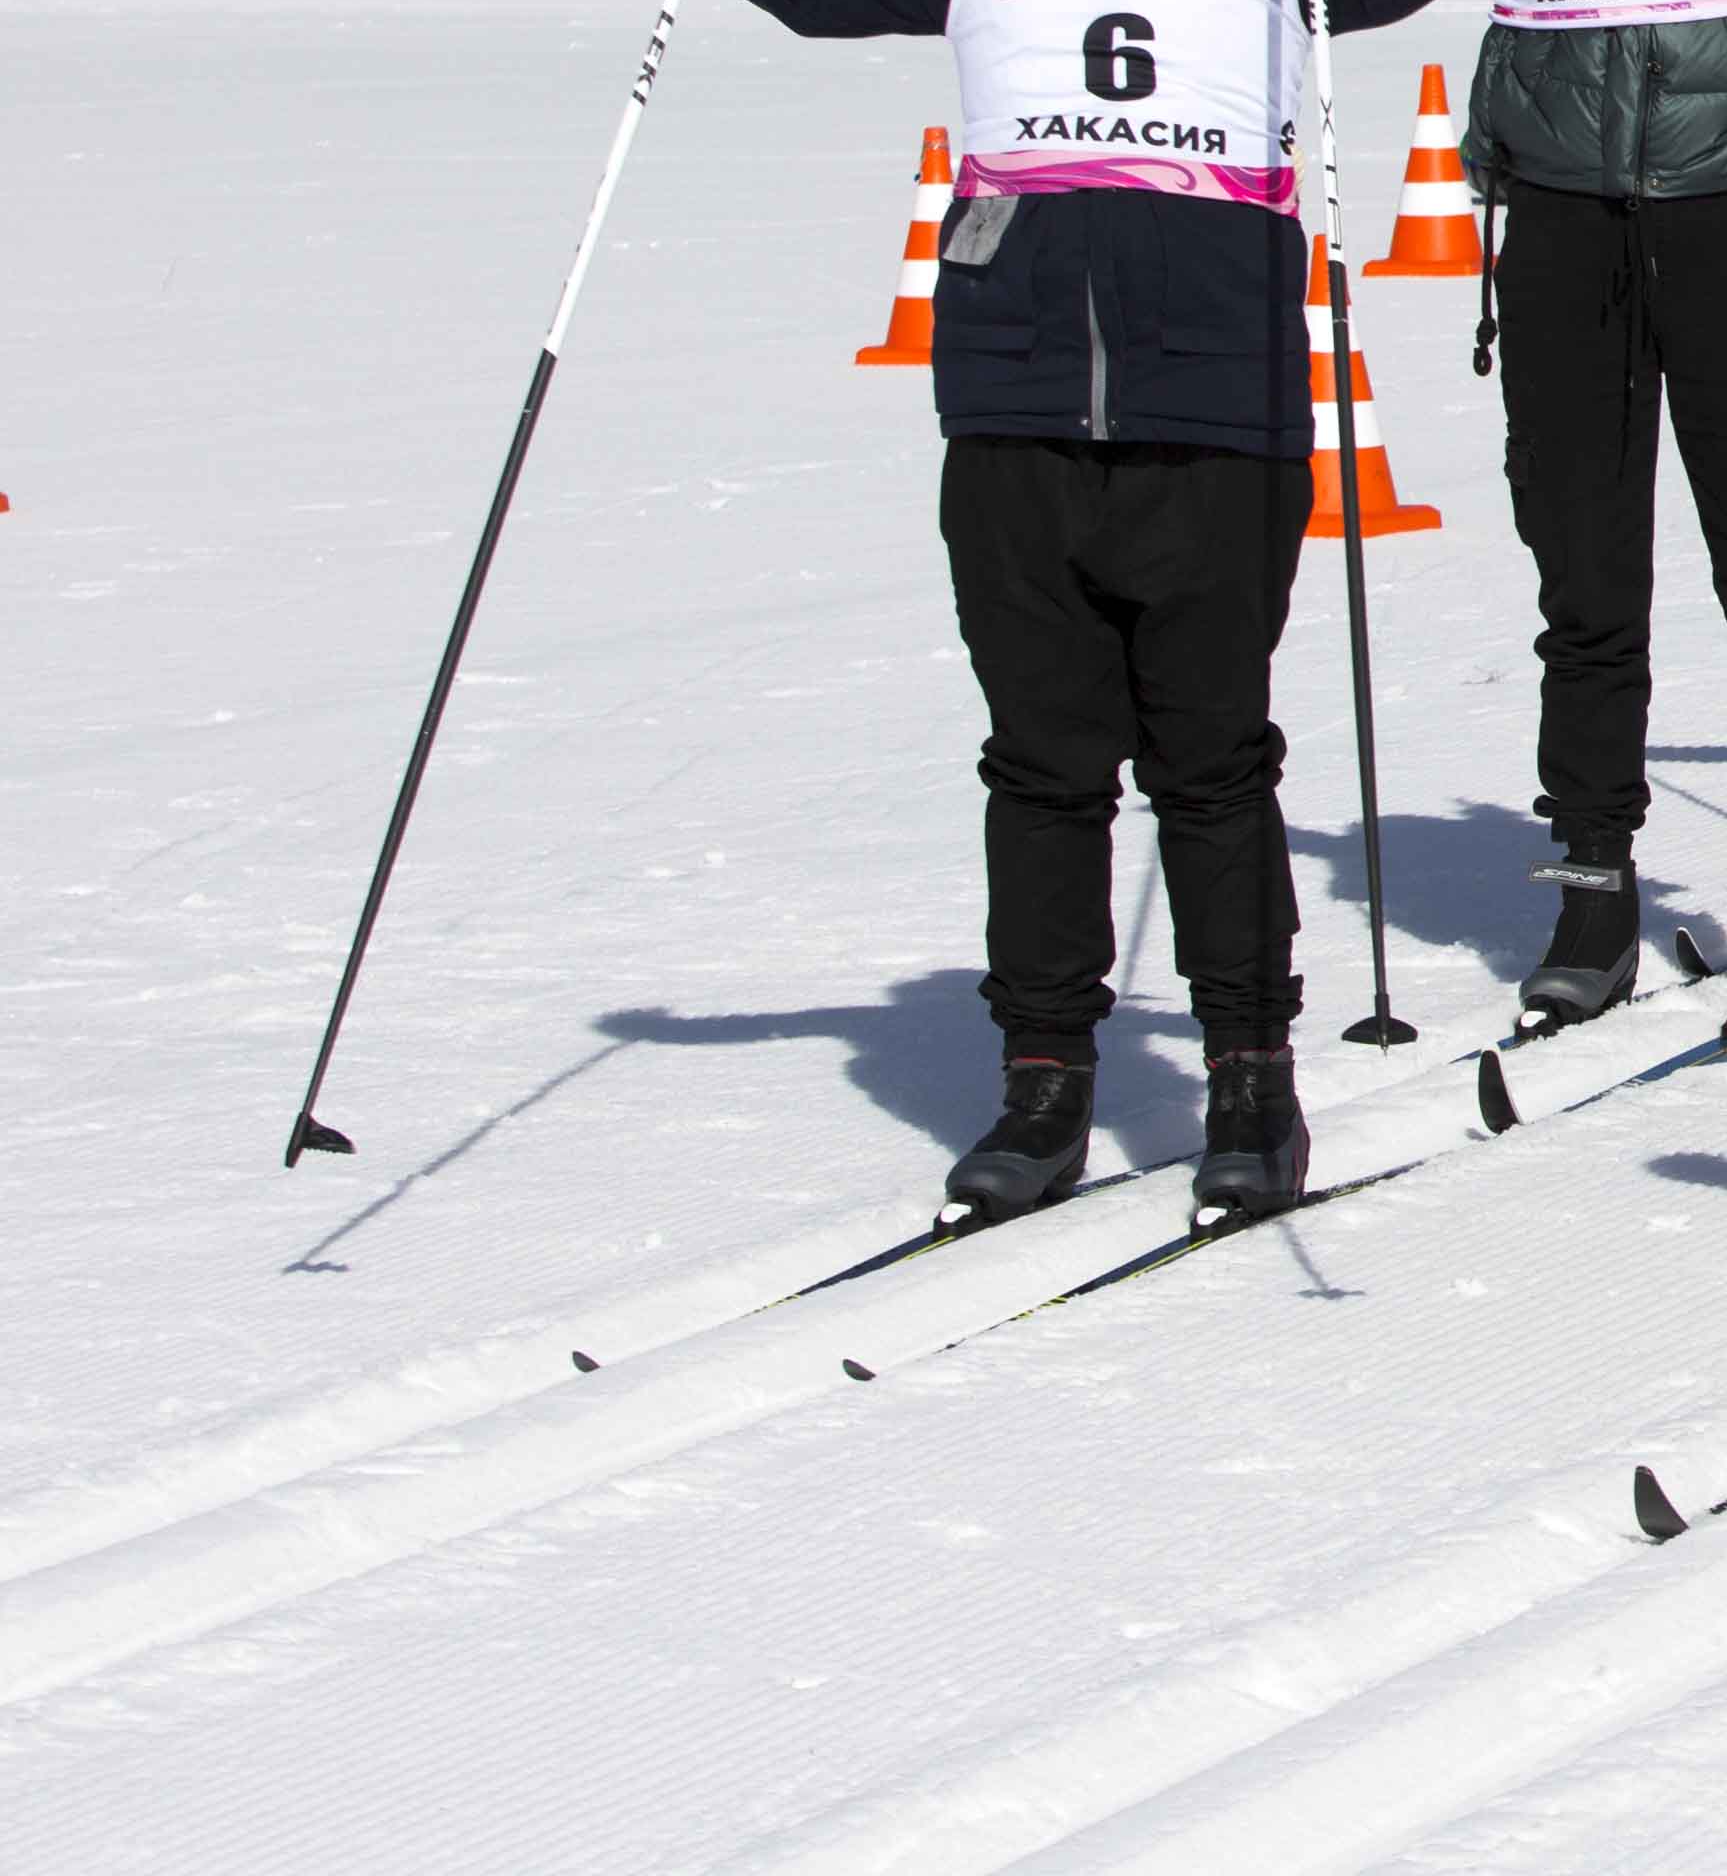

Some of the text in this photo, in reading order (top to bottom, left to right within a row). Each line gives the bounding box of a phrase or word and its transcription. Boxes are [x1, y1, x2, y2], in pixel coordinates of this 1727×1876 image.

[632, 10, 677, 105] LEKI
[1082, 12, 1156, 102] 6
[1016, 115, 1226, 156] ХАКАСИЯ
[1534, 867, 1608, 886] SPINE
